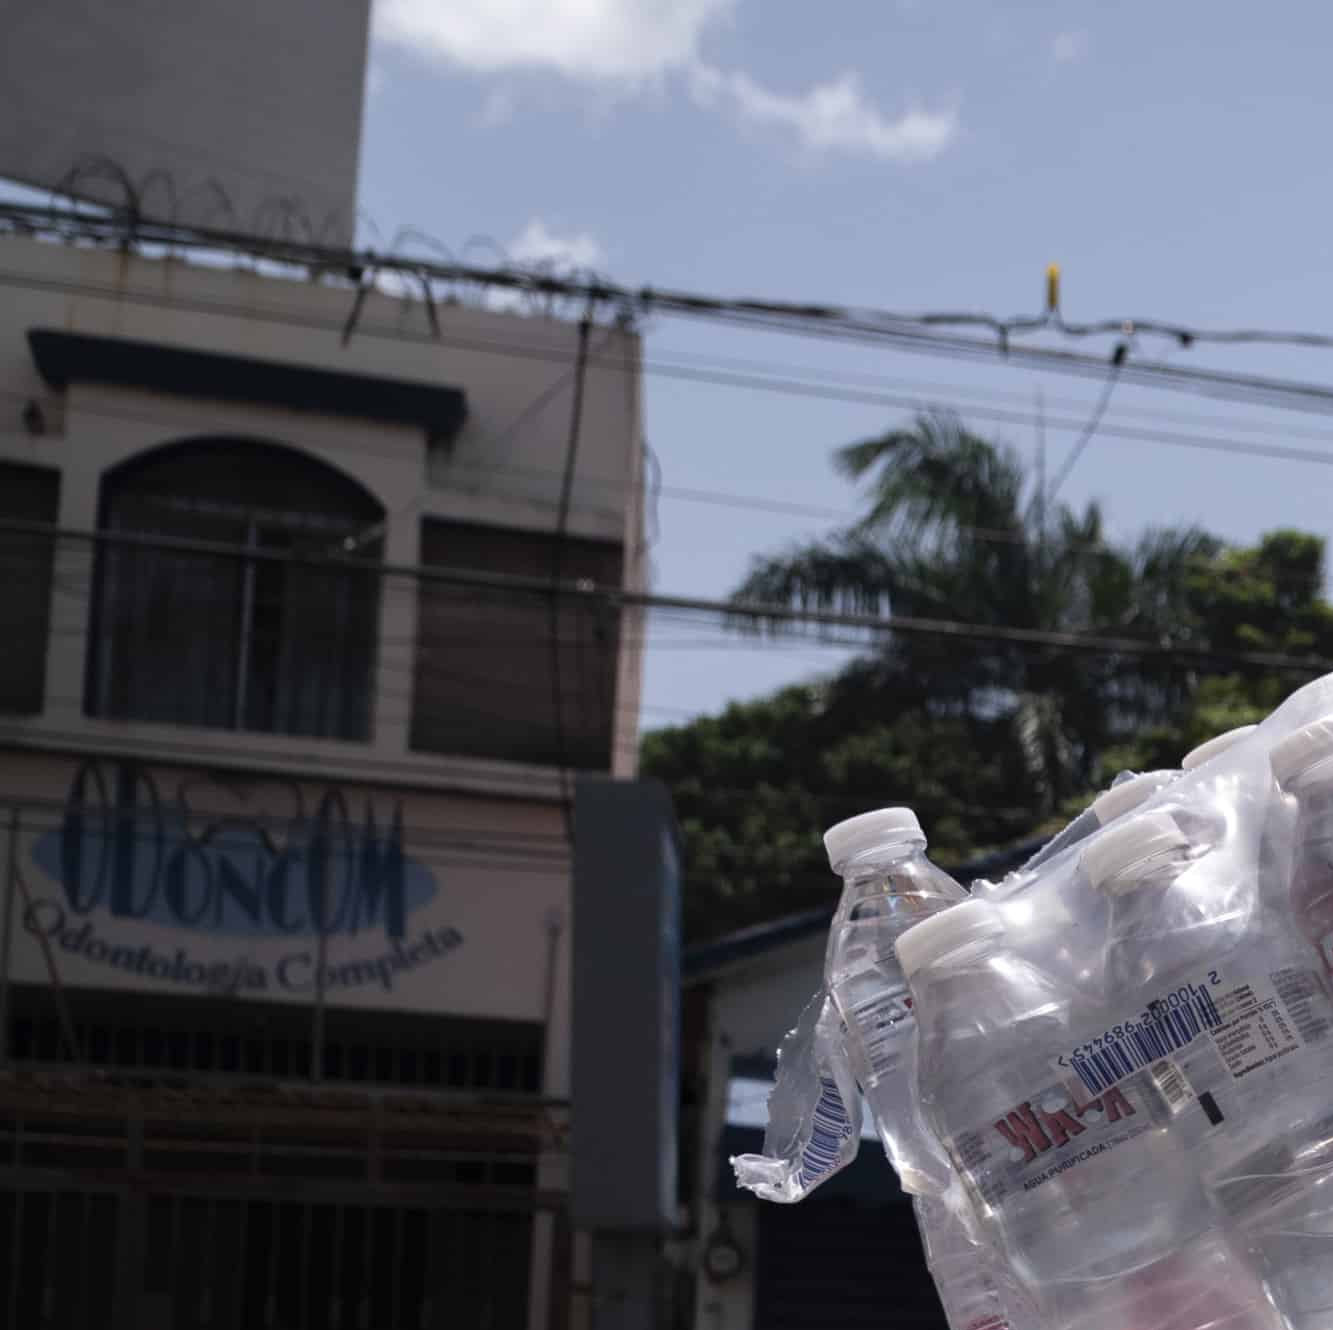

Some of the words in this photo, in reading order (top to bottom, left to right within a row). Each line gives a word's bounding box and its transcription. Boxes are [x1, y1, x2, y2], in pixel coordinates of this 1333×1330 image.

[275, 924, 464, 994] Completa
[1207, 970, 1222, 985] 2
[1072, 1021, 1135, 1061] 989445
